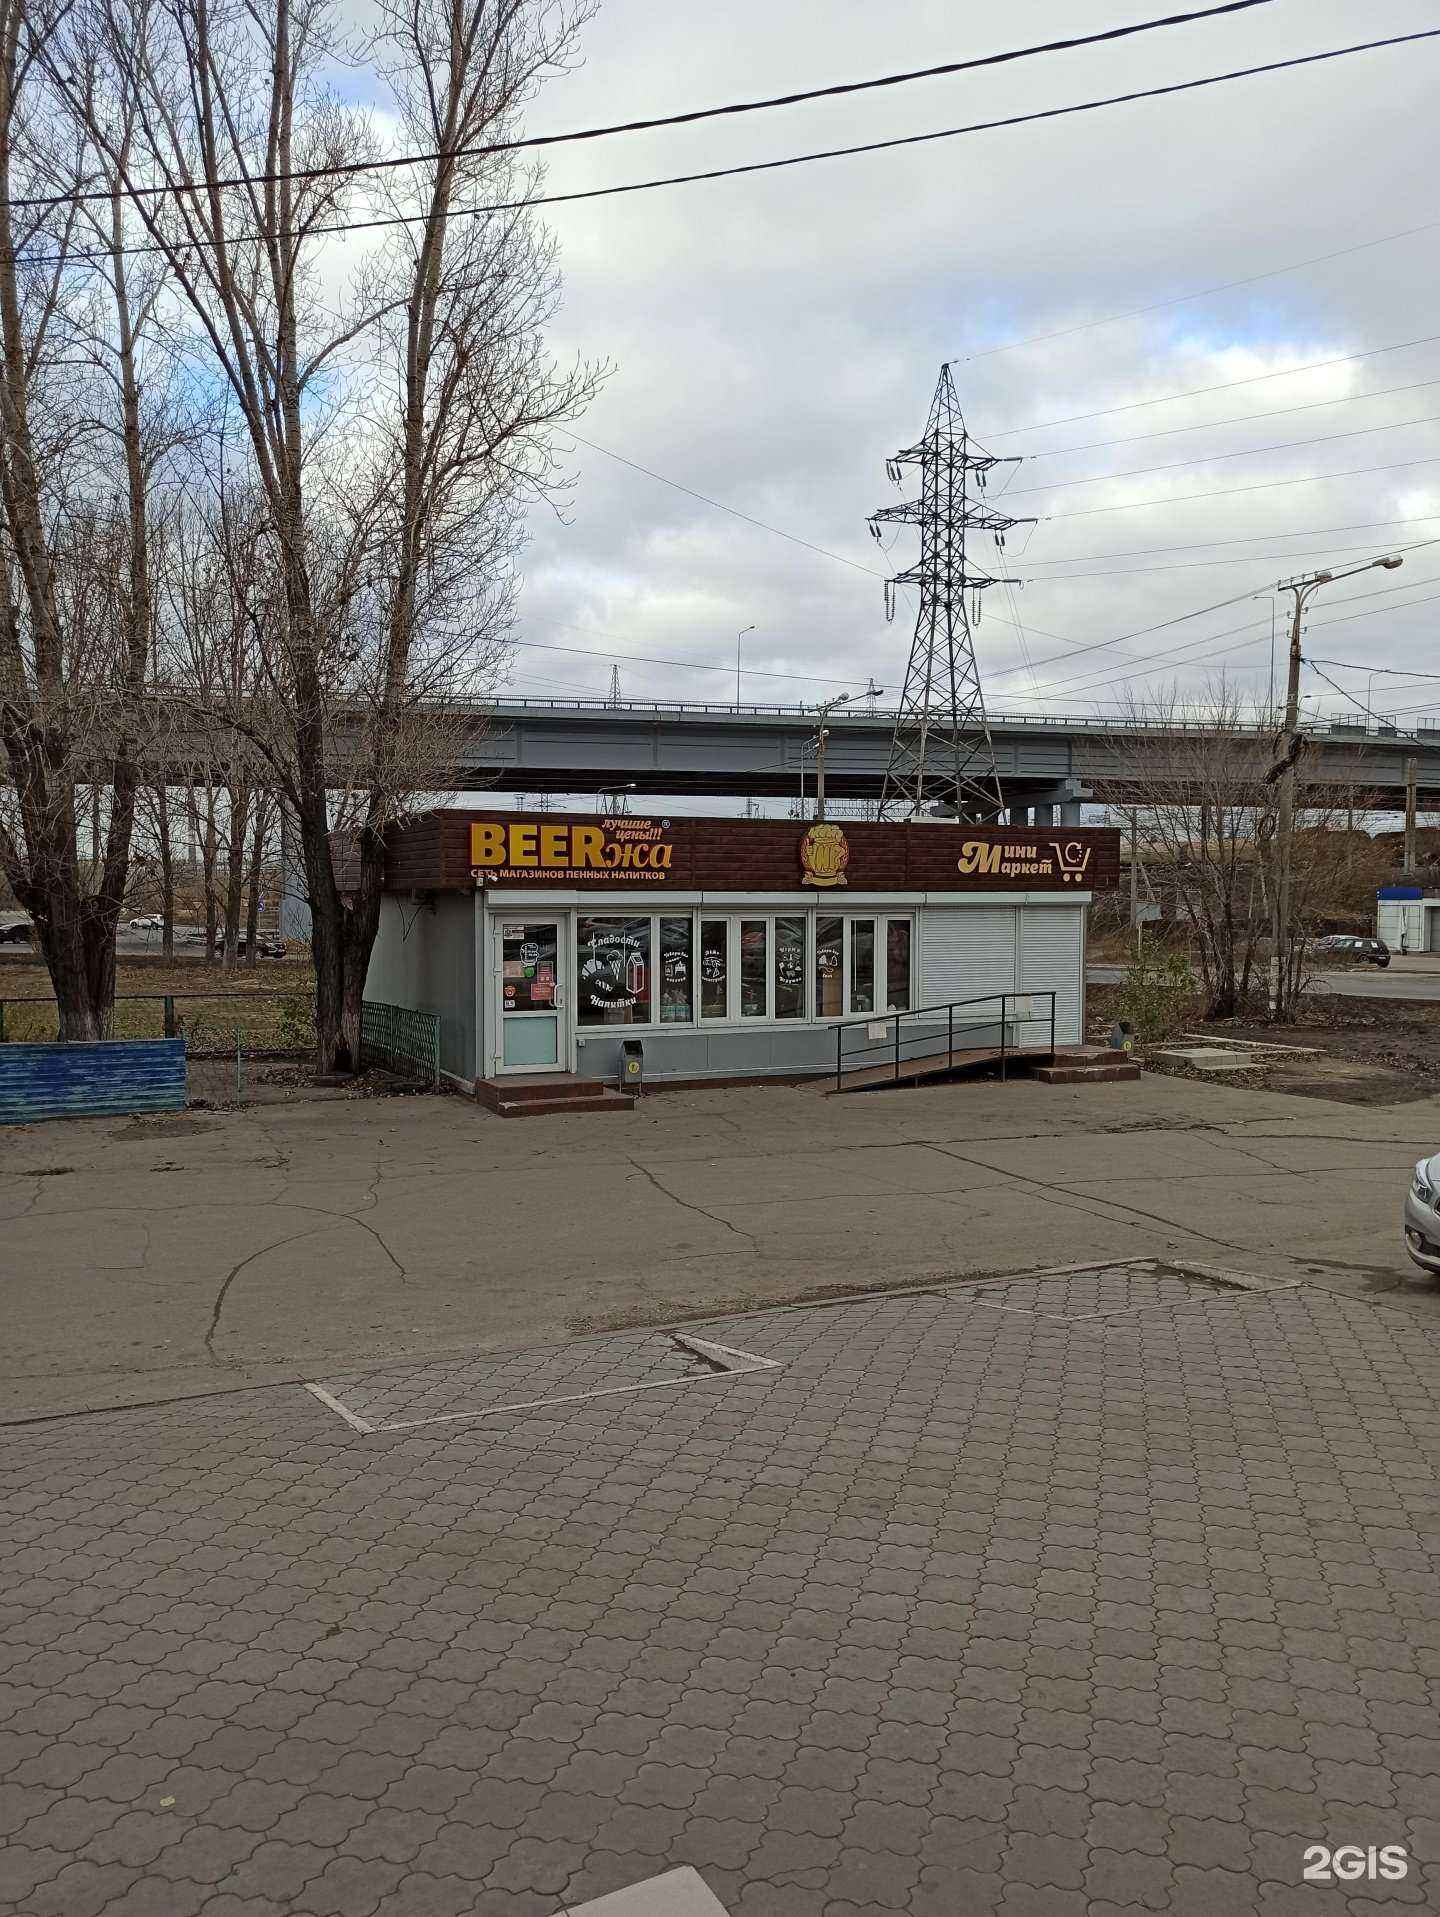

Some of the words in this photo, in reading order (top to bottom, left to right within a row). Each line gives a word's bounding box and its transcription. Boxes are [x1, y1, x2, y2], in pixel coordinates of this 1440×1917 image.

[602, 817, 652, 830] лучшие
[615, 827, 663, 842] цены!!!
[470, 868, 498, 878] СЕТЬ
[499, 869, 564, 879] МАГАЗИНОВ
[566, 870, 610, 879] ПЕННЫХ
[611, 870, 666, 880] НАПИТКОВ
[587, 934, 641, 948] Сладости
[590, 994, 637, 1009] Напитки
